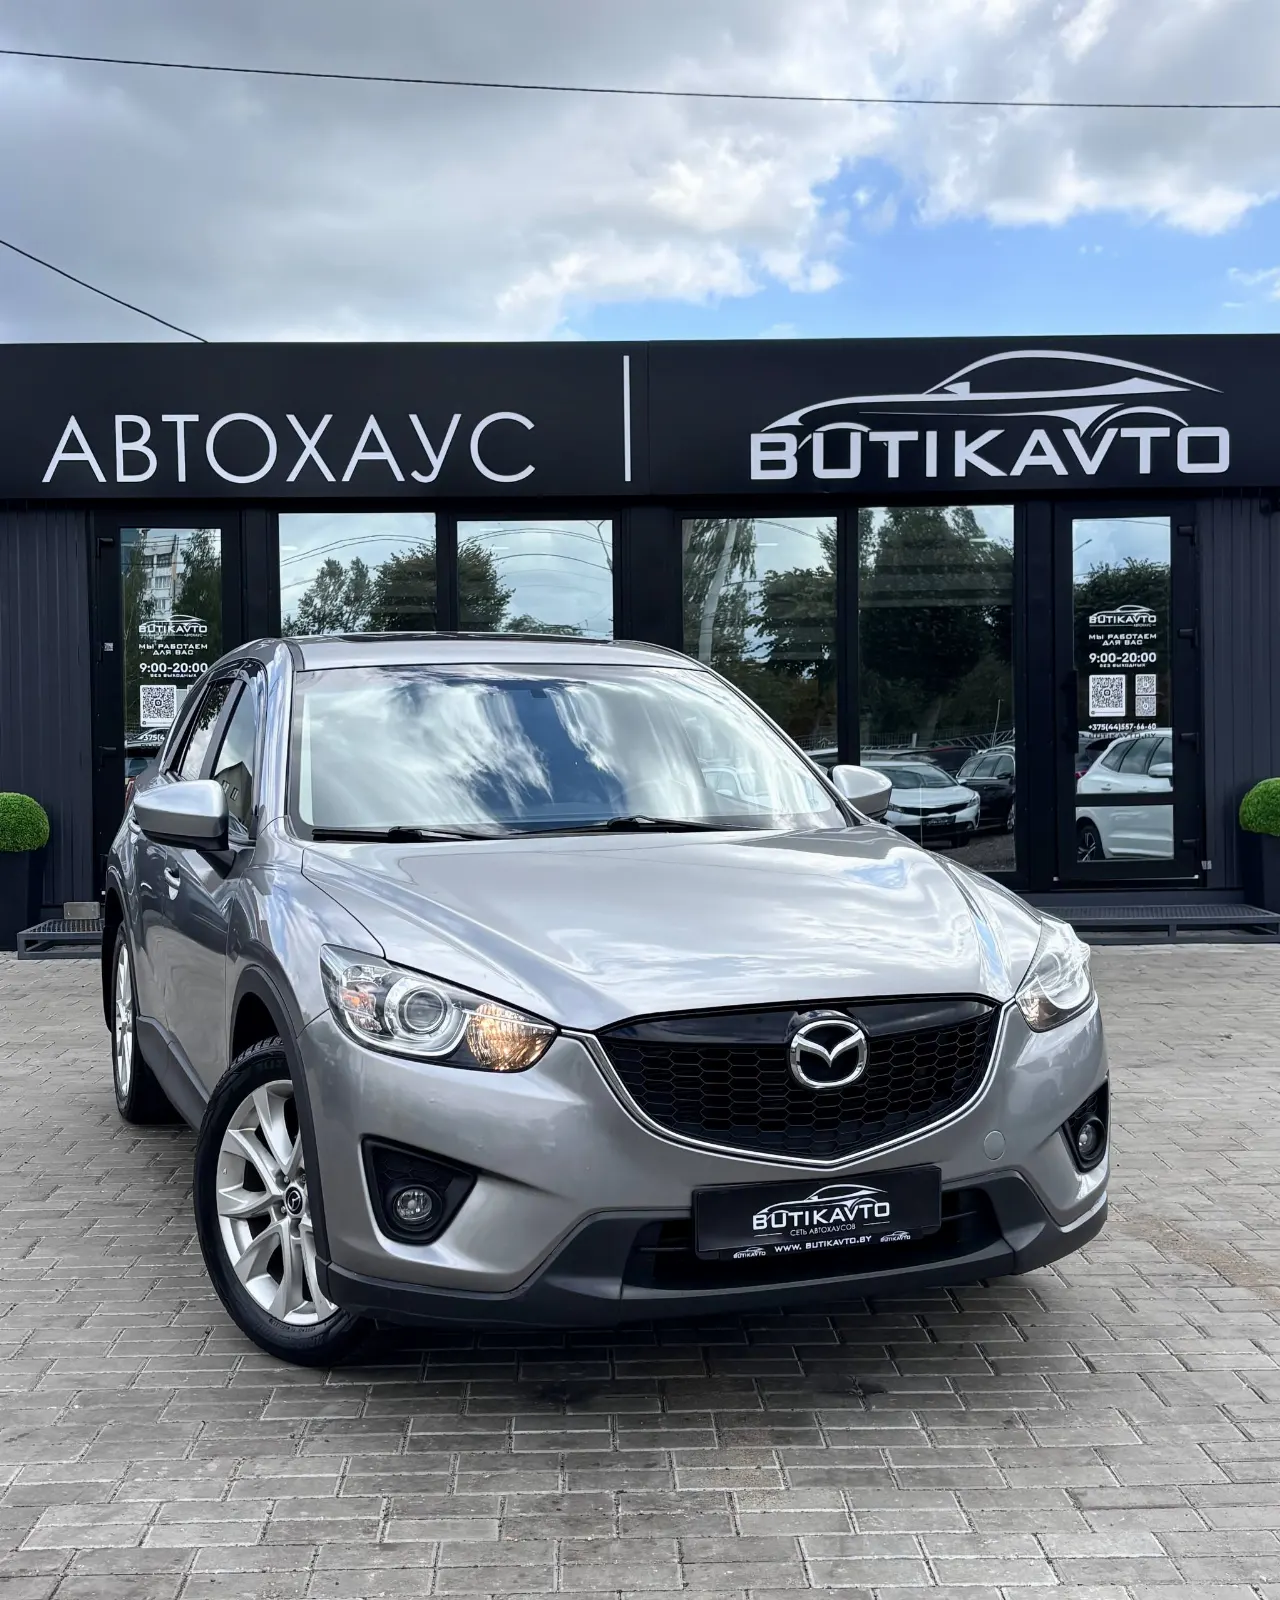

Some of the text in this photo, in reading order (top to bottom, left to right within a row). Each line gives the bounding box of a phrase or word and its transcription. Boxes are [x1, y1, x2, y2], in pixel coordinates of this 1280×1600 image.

[42, 411, 535, 484] АВТОХАУС
[750, 426, 1230, 480] BUTIKAVTO
[1089, 615, 1157, 623] BUTIKAVTO
[138, 625, 208, 633] BUTIKAVTO
[1089, 652, 1157, 663] 9:00-20:00
[139, 662, 209, 673] 9:00-20:00
[752, 1202, 890, 1231] BUTIKAVTO
[790, 1223, 857, 1237] СЕТЬ АВТОХАУСОВ
[805, 1235, 872, 1249] BUTIKAVTO.BY
[733, 1250, 767, 1259] BUTIKAVTO
